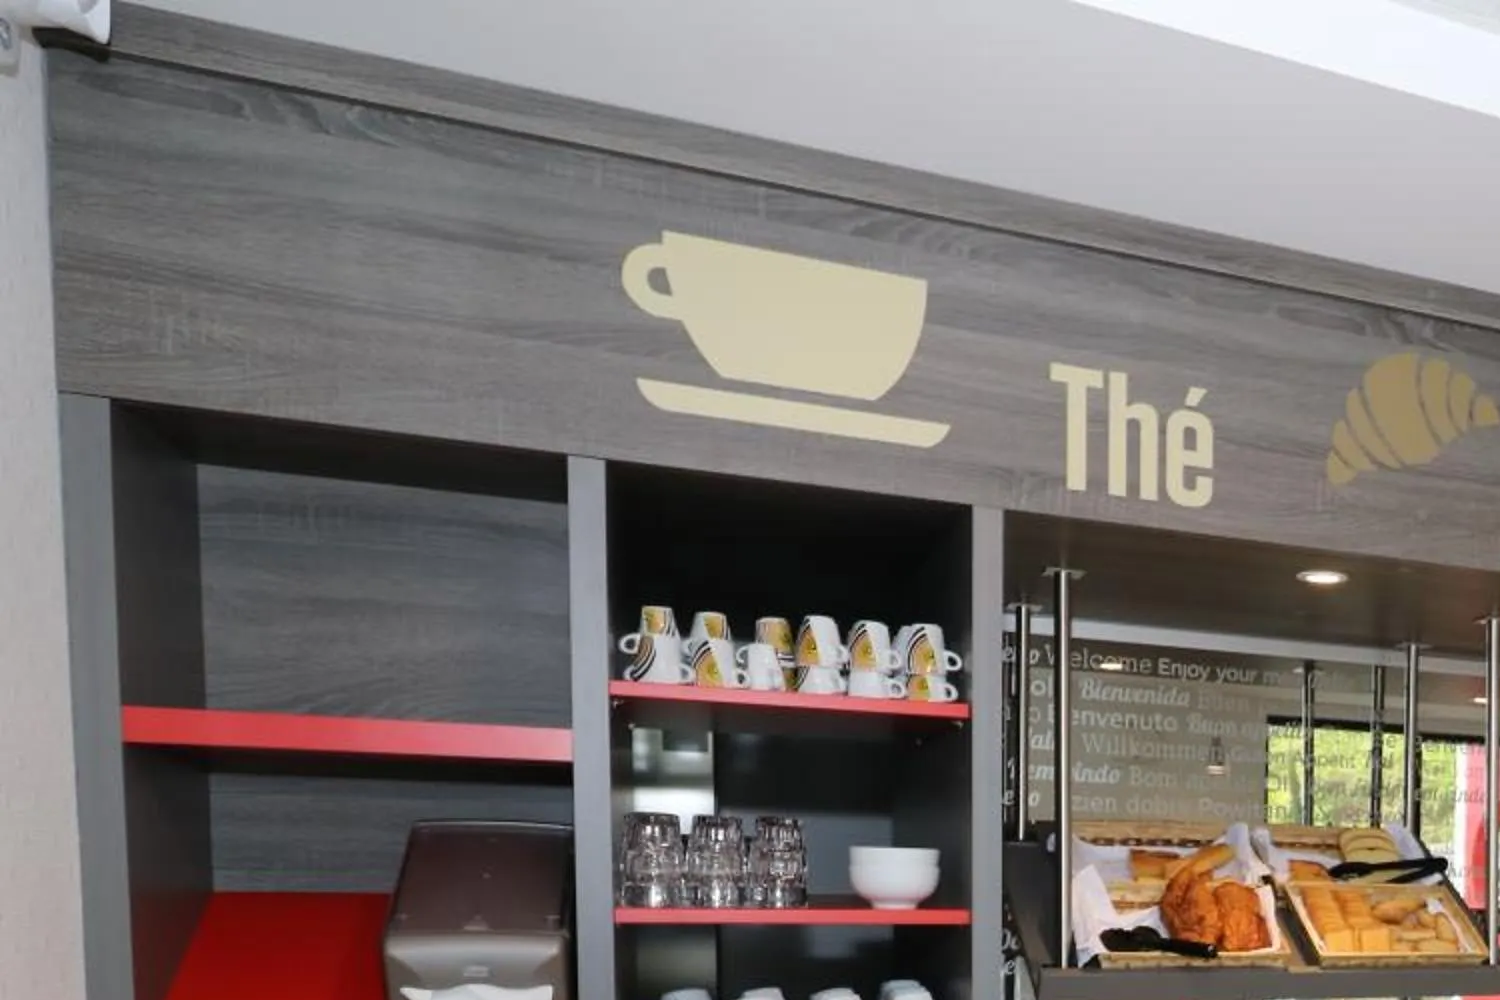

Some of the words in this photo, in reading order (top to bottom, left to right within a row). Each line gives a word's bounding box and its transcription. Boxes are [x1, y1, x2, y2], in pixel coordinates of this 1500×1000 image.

[1049, 362, 1214, 508] Thé
[1158, 658, 1210, 683] Enjoy
[1216, 666, 1257, 685] your
